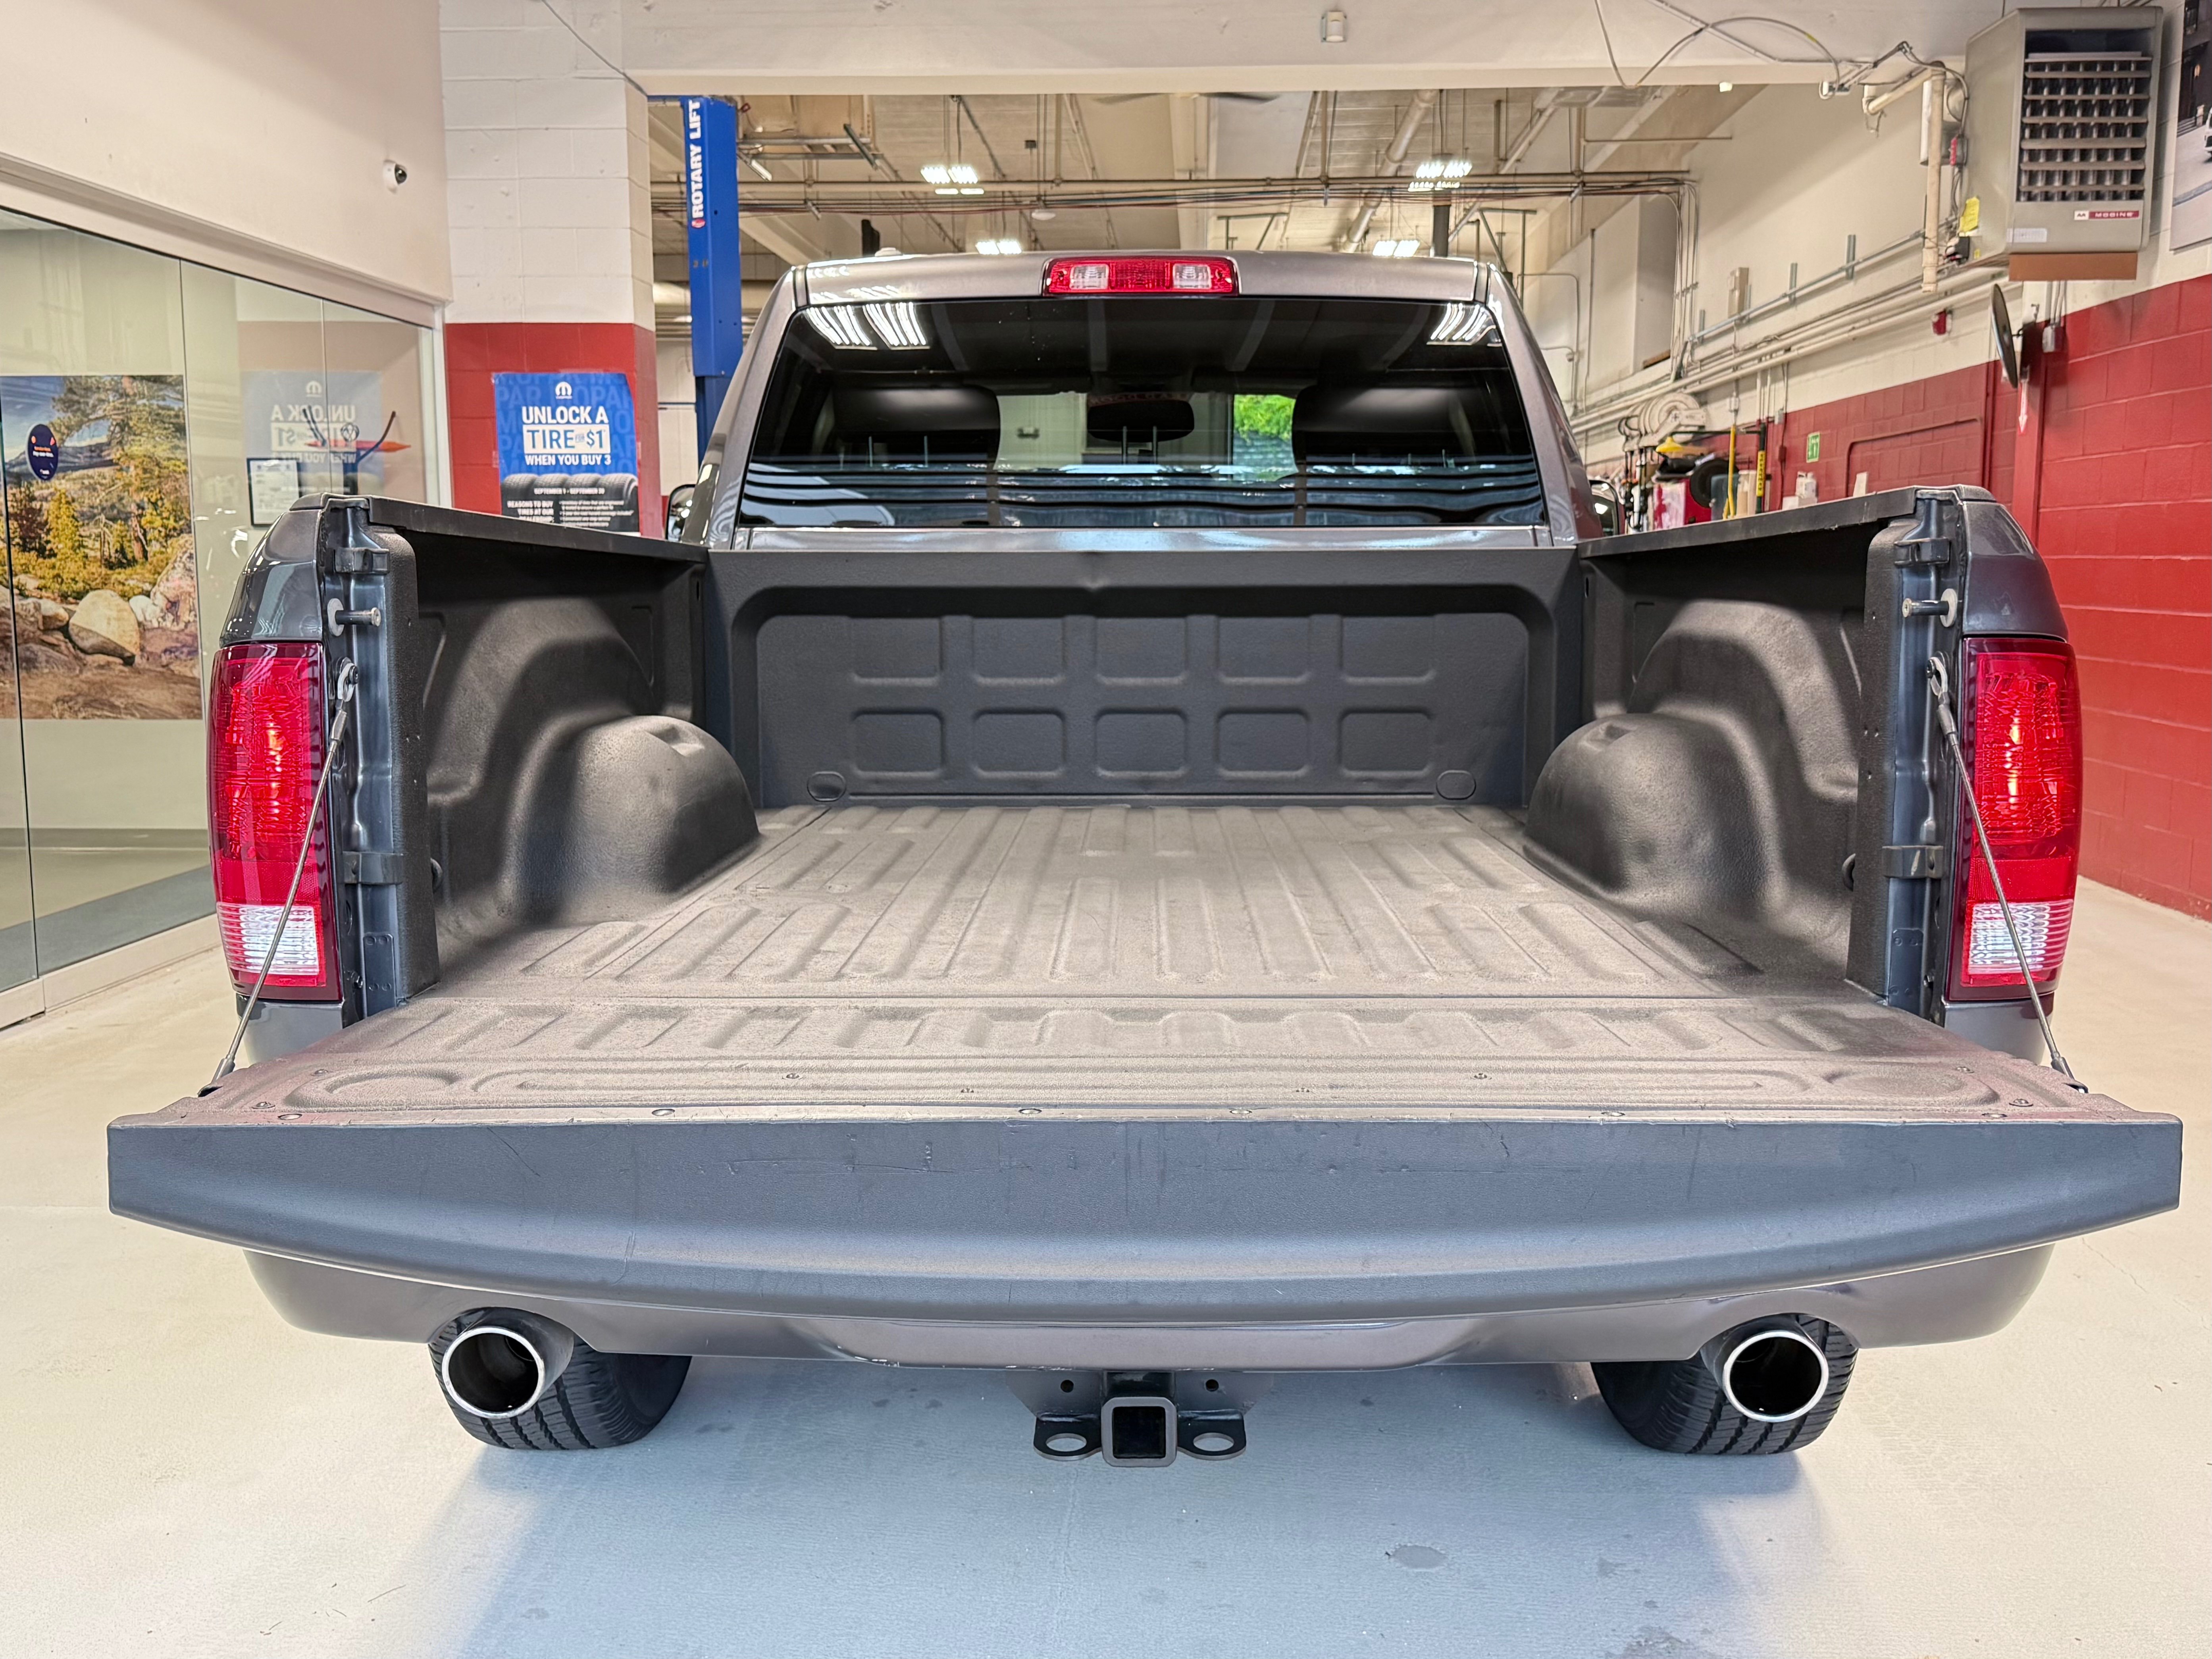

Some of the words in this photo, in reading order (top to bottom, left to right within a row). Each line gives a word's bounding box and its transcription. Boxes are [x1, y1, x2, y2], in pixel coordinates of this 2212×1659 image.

[689, 100, 701, 139] LIFT
[690, 144, 704, 218] ROTARY
[522, 406, 592, 423] UNLOCK
[595, 406, 609, 423] A
[526, 429, 575, 449] TIRE
[525, 455, 556, 465] WHEN
[557, 455, 579, 465] YOU
[581, 455, 602, 465] BUY
[604, 455, 612, 465] 3
